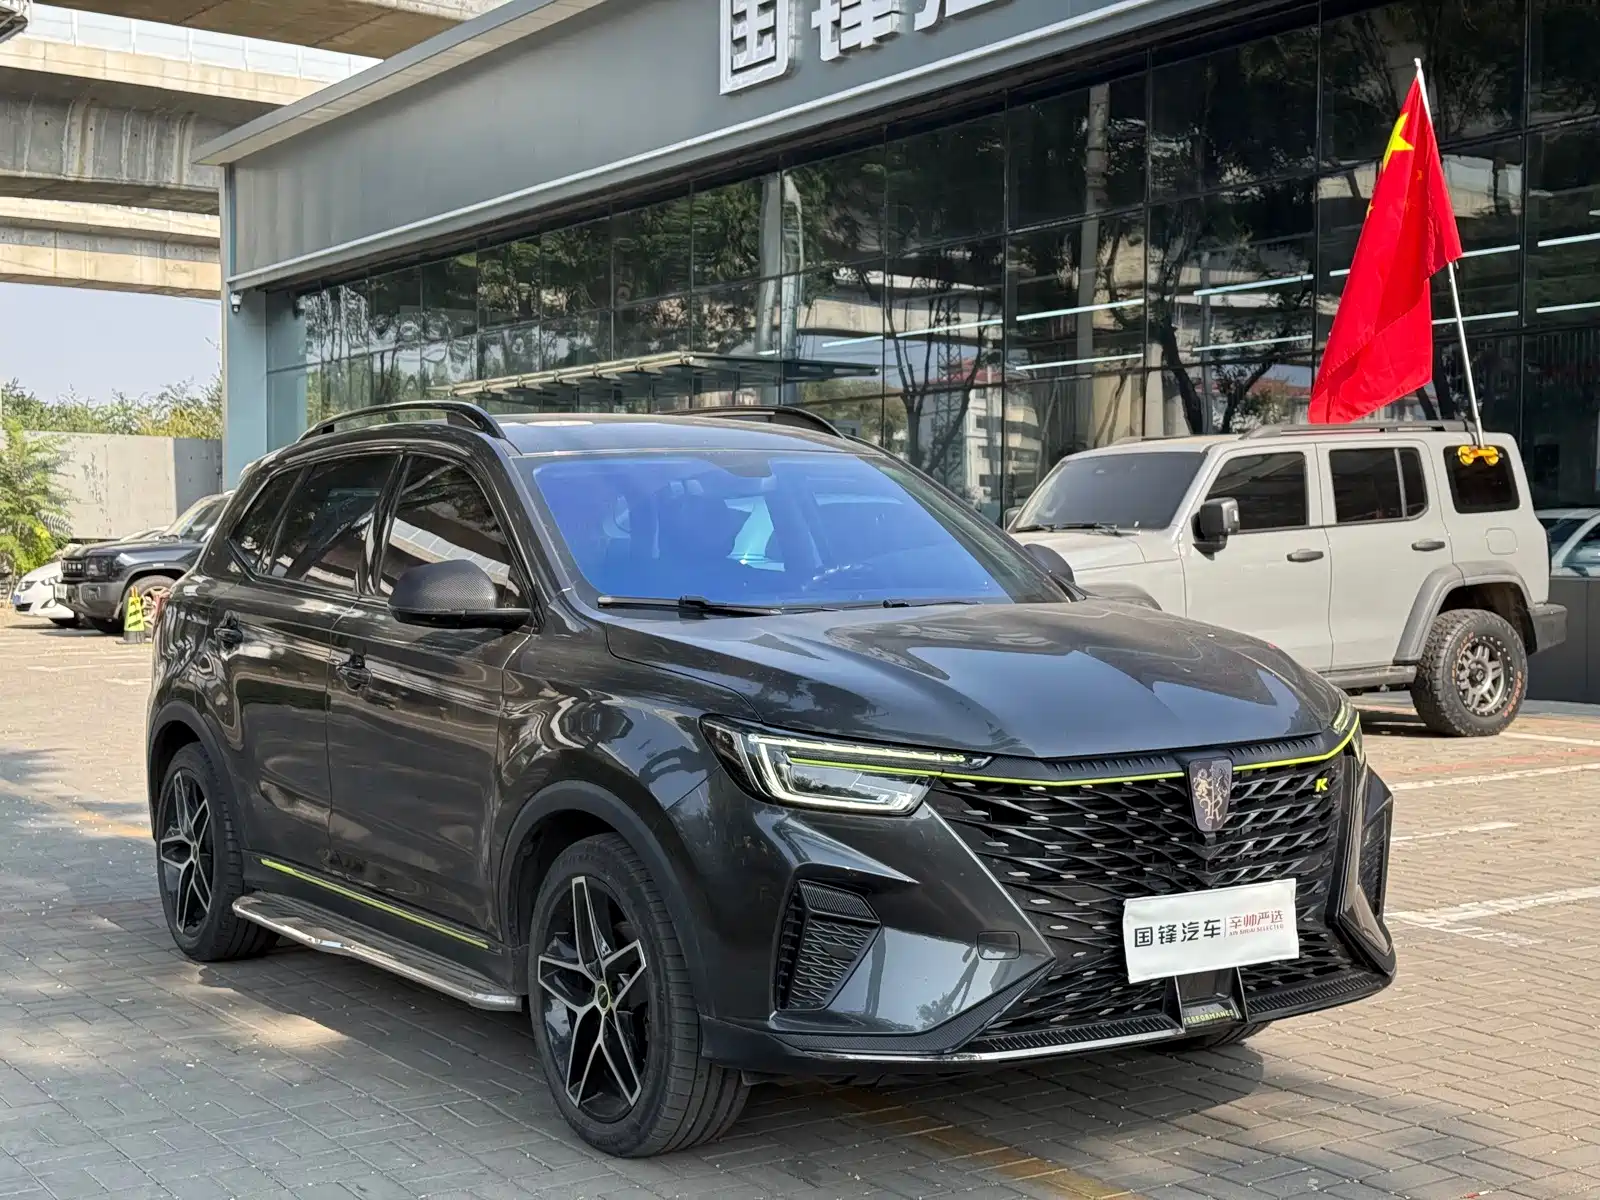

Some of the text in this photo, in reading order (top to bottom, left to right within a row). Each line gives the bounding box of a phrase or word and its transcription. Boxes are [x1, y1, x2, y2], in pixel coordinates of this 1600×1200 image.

[1229, 910, 1283, 928] 辛帅严选
[1134, 919, 1221, 947] 国锋汽车
